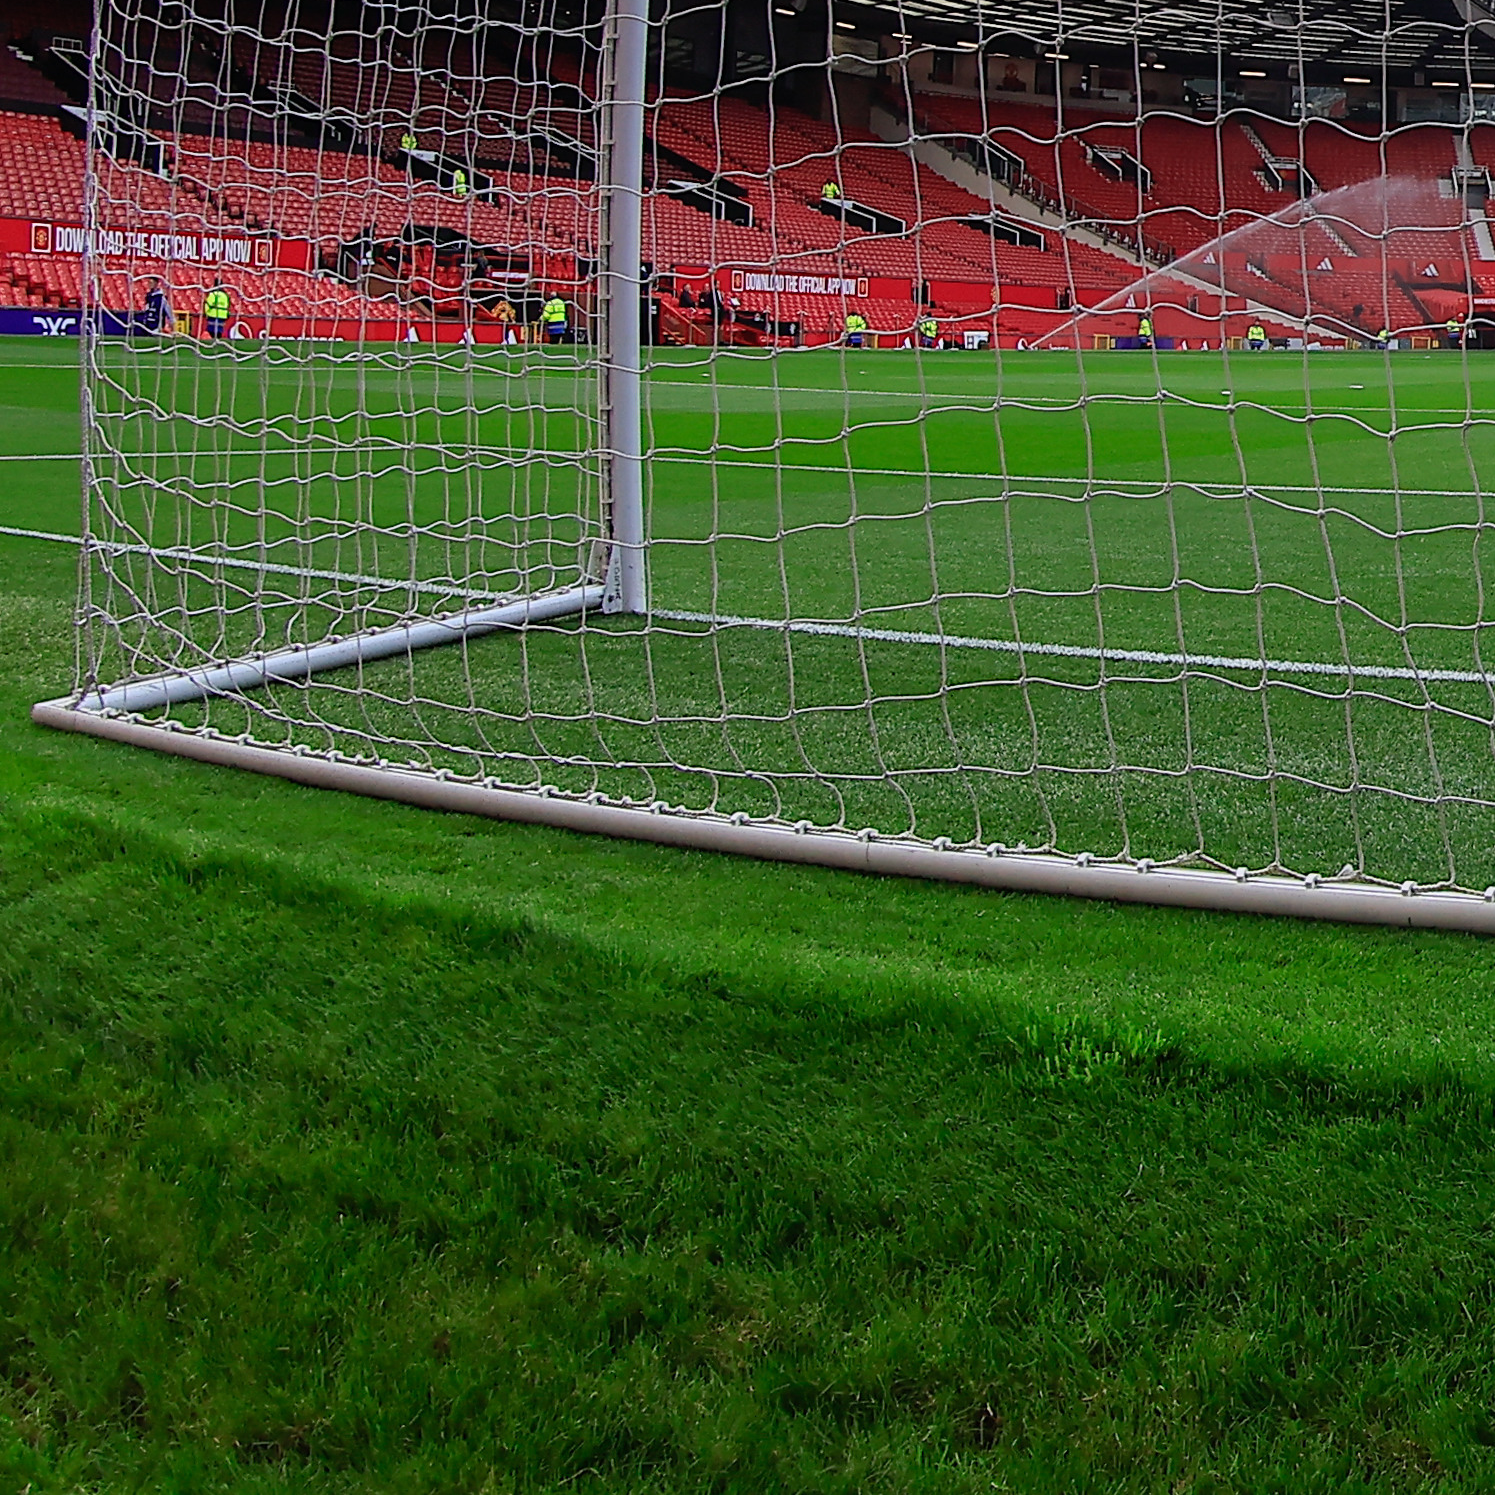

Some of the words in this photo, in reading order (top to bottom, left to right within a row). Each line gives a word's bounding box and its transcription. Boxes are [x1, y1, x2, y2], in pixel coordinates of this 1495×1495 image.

[125, 231, 149, 258] THE
[150, 233, 199, 261] OFFICIAL
[202, 237, 223, 262] APP
[225, 239, 252, 263] NOW
[785, 275, 798, 292] THE
